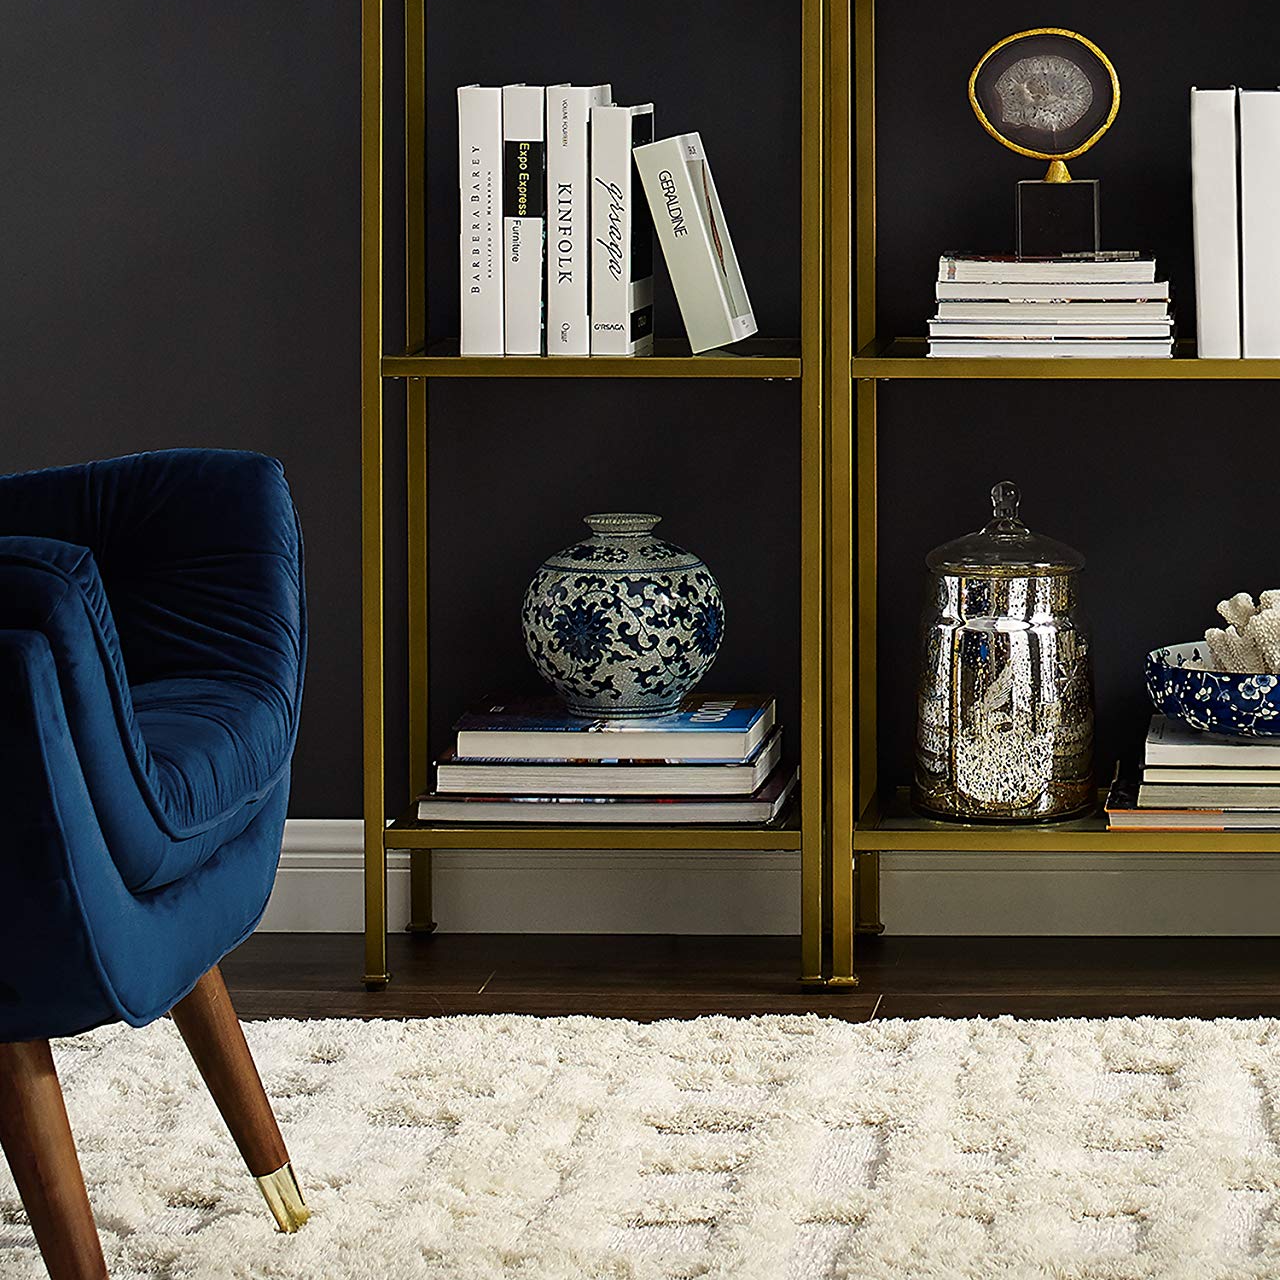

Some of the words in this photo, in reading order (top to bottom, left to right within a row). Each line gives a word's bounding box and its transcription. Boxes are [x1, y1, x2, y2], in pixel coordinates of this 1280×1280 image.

[518, 142, 530, 170] Expo
[518, 172, 530, 216] Express
[658, 169, 688, 239] GERALDINE
[511, 220, 522, 263] Furniture
[558, 182, 573, 284] KINFOLK
